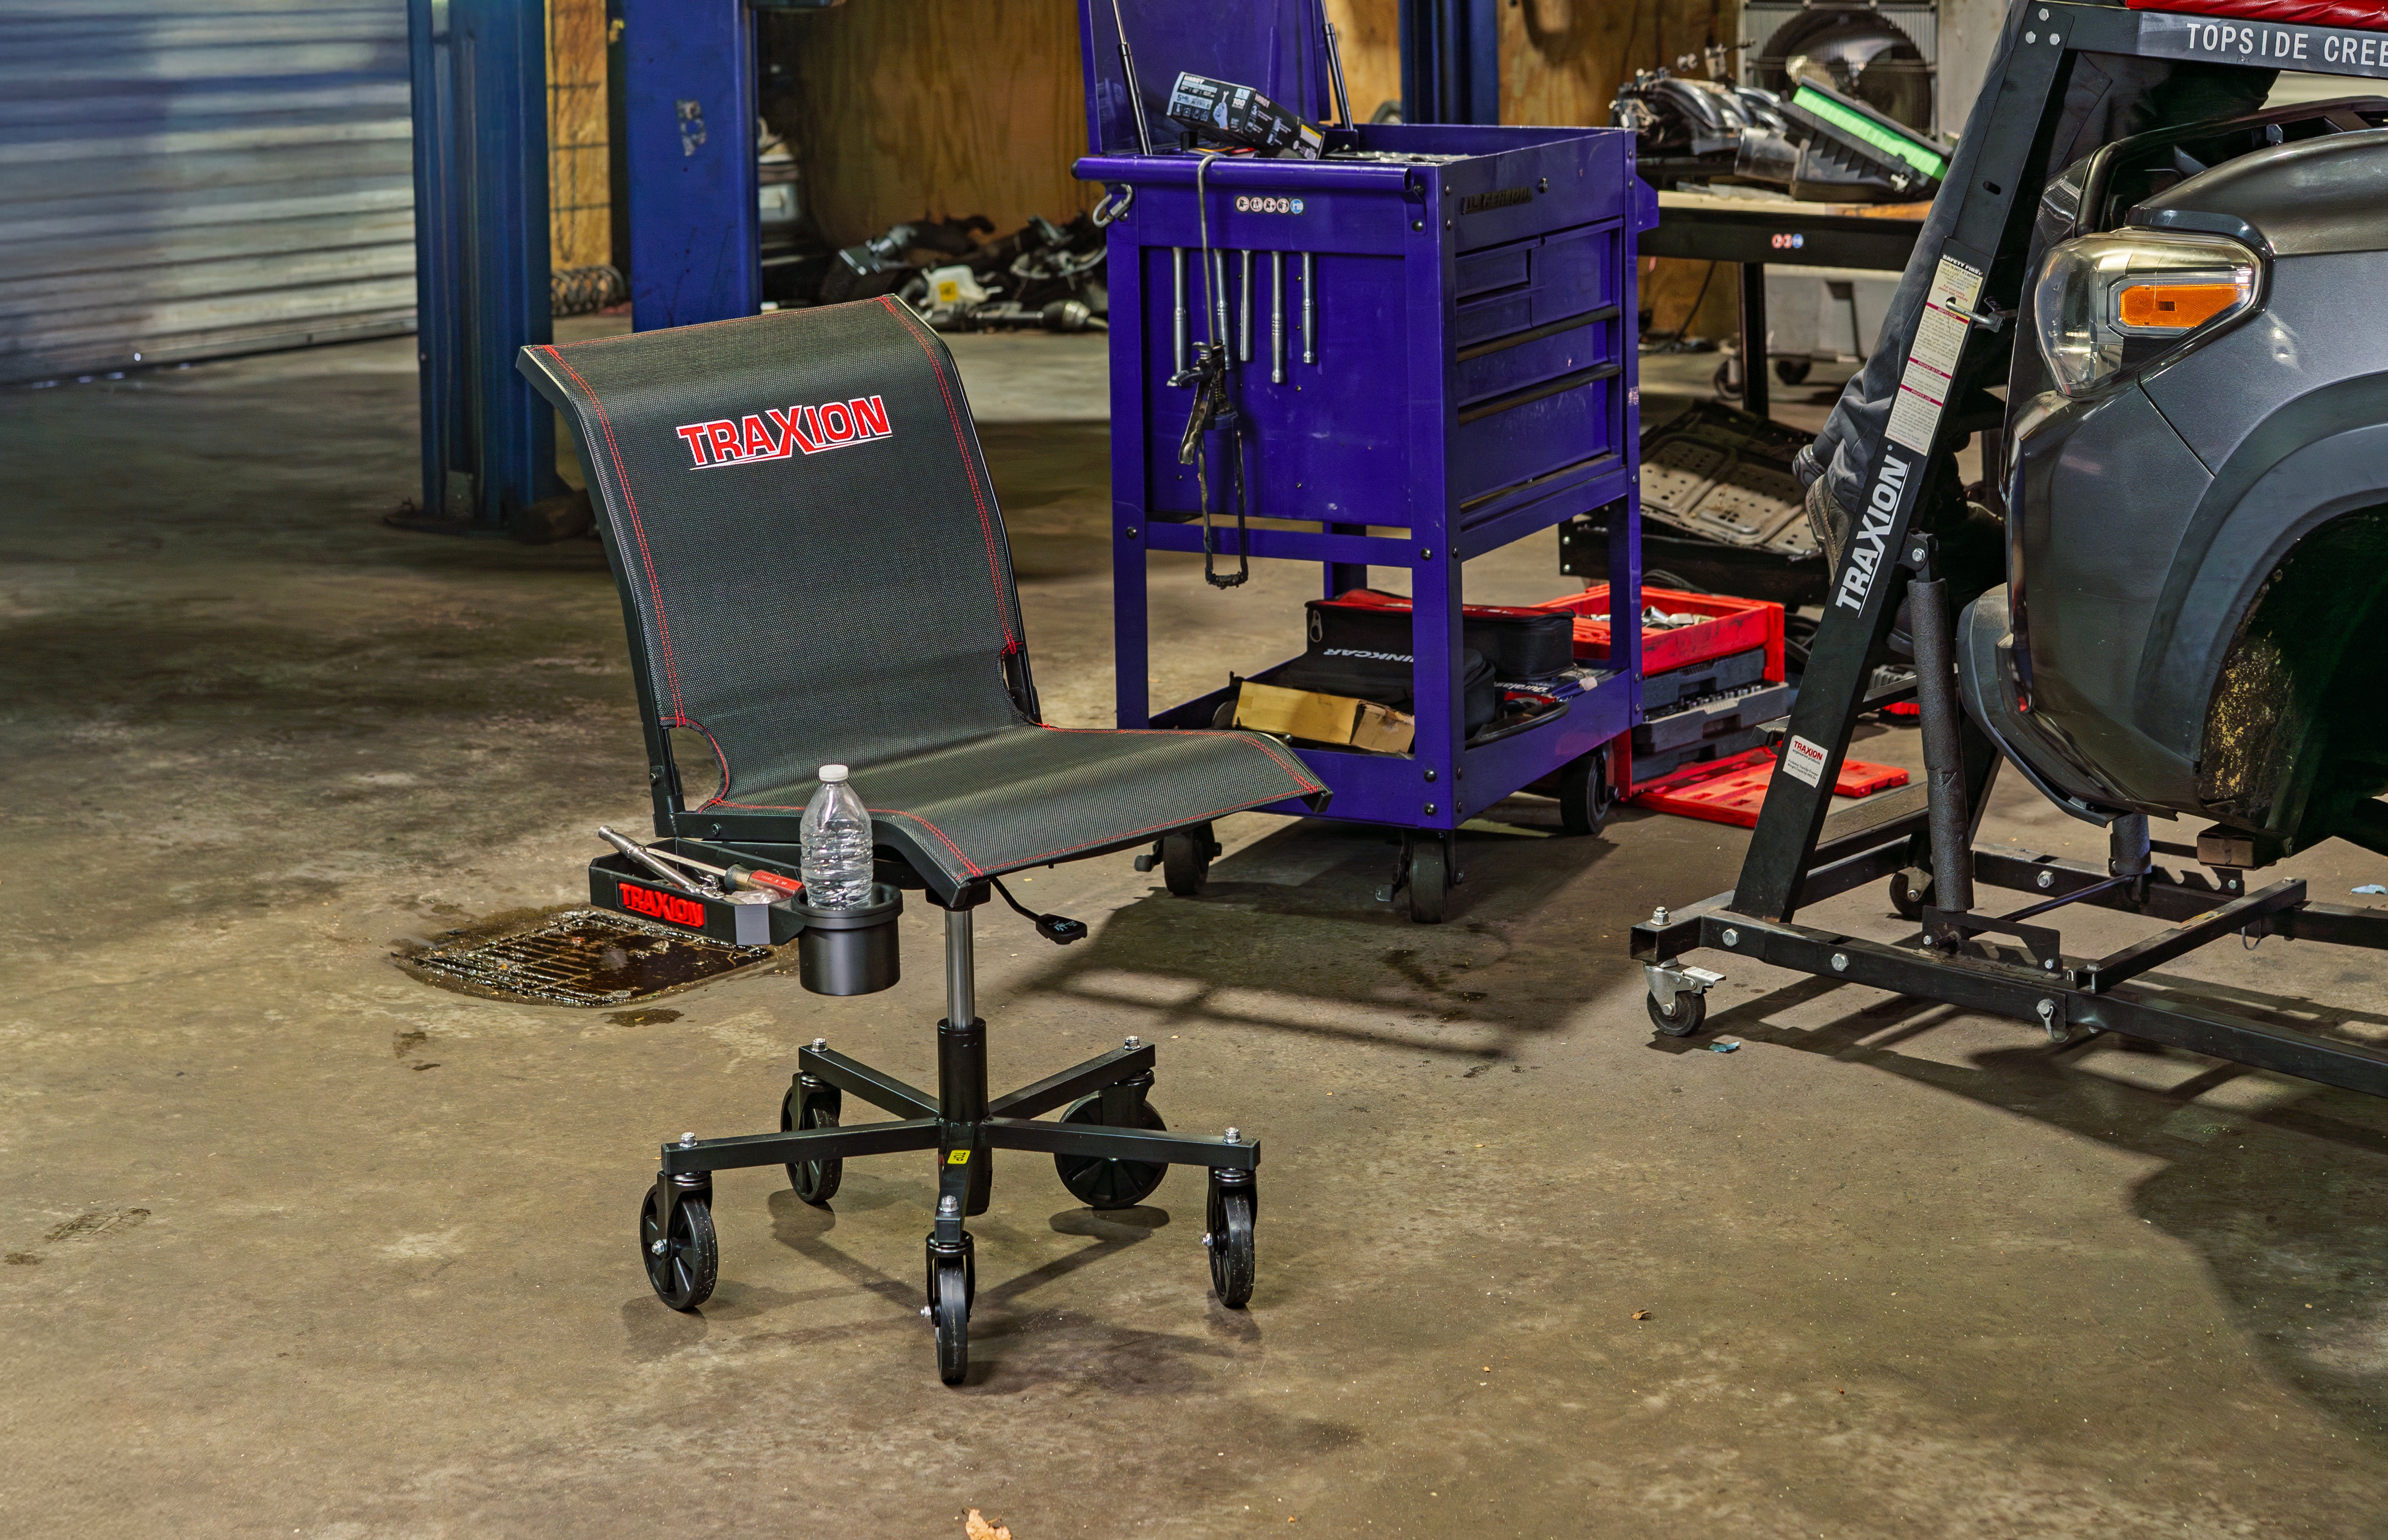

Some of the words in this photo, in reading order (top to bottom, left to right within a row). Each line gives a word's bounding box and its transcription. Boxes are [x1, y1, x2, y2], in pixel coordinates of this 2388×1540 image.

[2187, 23, 2309, 60] TOPSIDE
[1233, 98, 1246, 107] 100
[1942, 254, 1965, 267] SAFETY
[1965, 272, 1979, 281] LADDER
[1917, 361, 1931, 371] PROPER
[1911, 389, 1924, 399] PROPER
[676, 395, 892, 469] TRAXION
[1835, 454, 1910, 616] TRAXION
[1323, 648, 1414, 662] INKCAR
[1794, 741, 1823, 760] TRAXION
[1808, 756, 1820, 765] products
[619, 882, 705, 928] TRAXION
[952, 1152, 966, 1161] TOP
